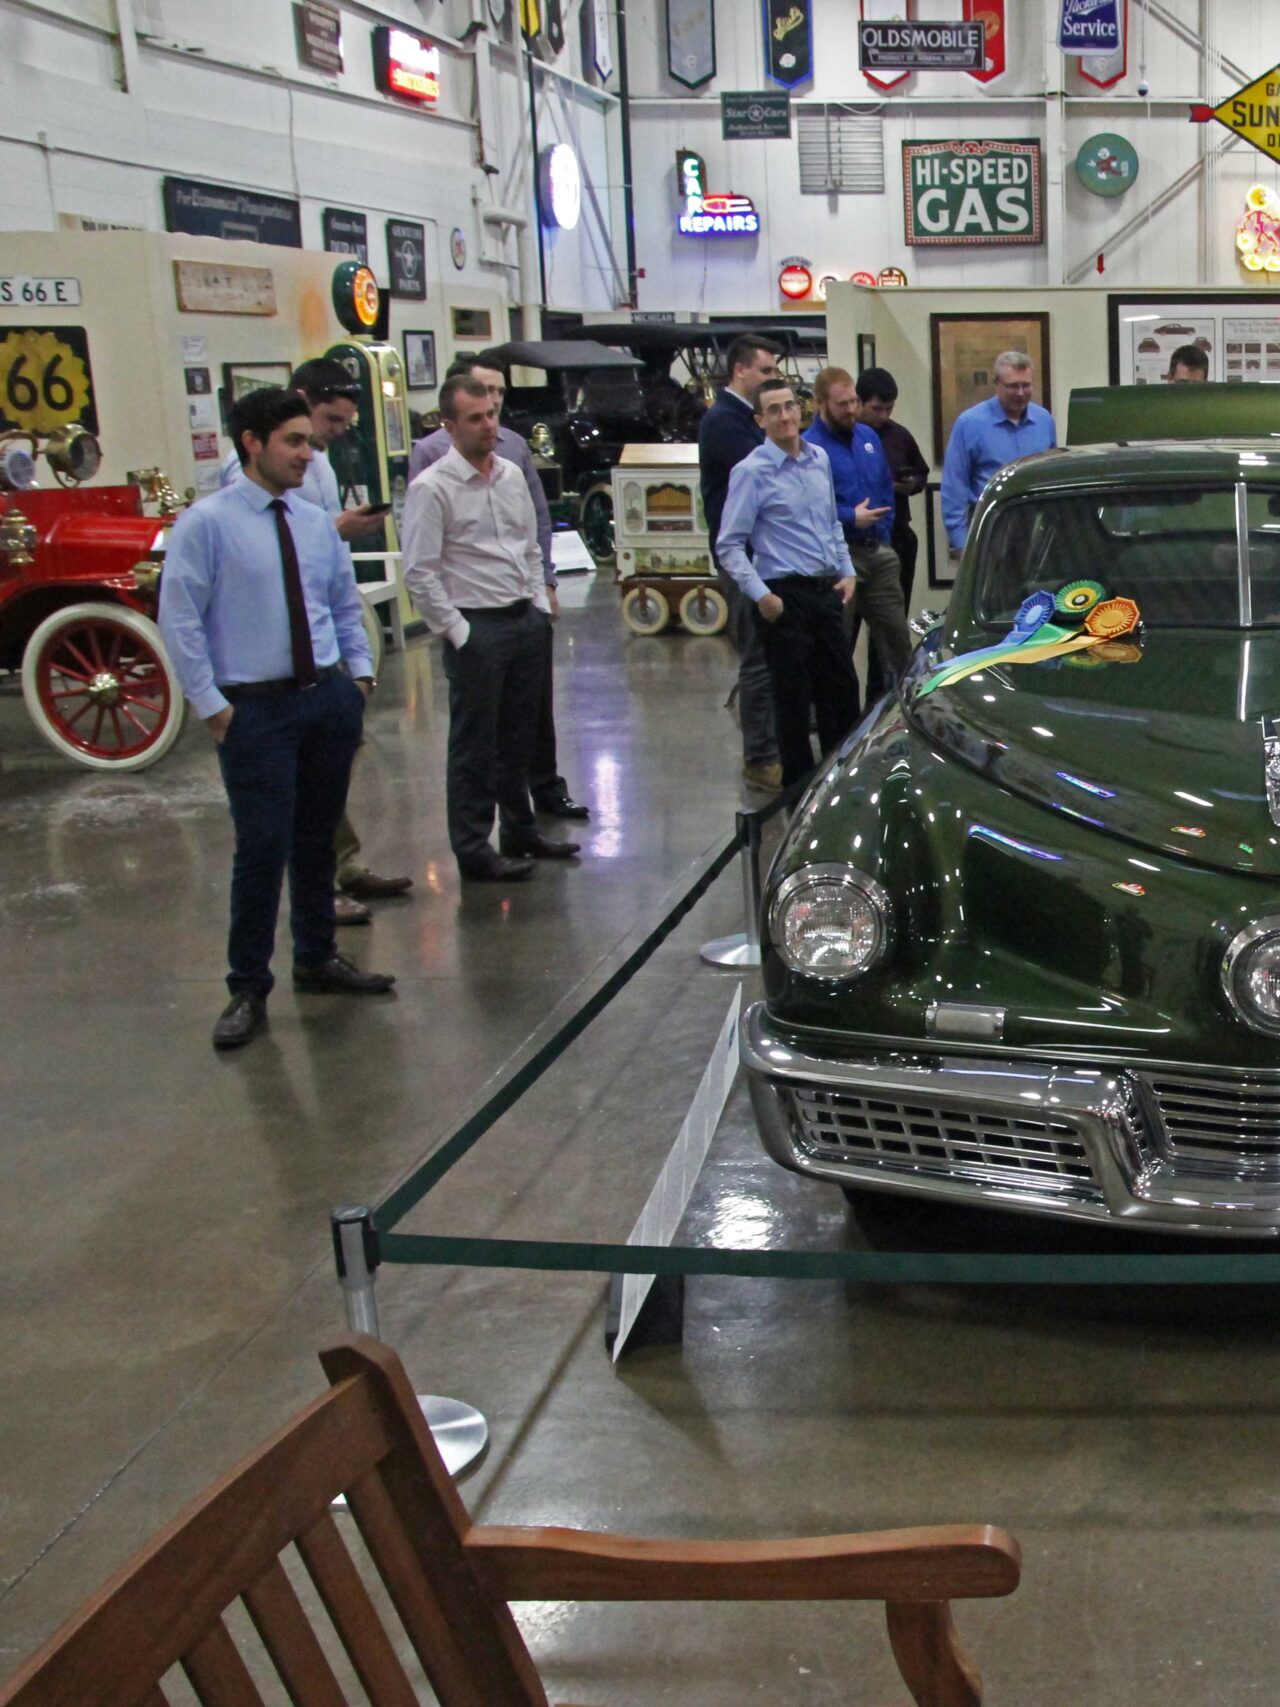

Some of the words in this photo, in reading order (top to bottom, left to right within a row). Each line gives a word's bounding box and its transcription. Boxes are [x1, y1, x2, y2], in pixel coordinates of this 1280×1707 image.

[1063, 16, 1116, 36] Service
[862, 27, 979, 48] OLDSMOBILE
[726, 107, 747, 118] Star
[764, 107, 787, 118] Cars
[916, 158, 1028, 185] HI-SPEED
[683, 158, 704, 213] CAR
[917, 187, 1029, 233] GAS
[680, 214, 758, 232] REPAIRS
[22, 282, 47, 302] 66
[55, 281, 68, 302] E
[398, 277, 421, 292] PARTS
[634, 313, 674, 321] MICHIGAN
[7, 353, 74, 412] 66
